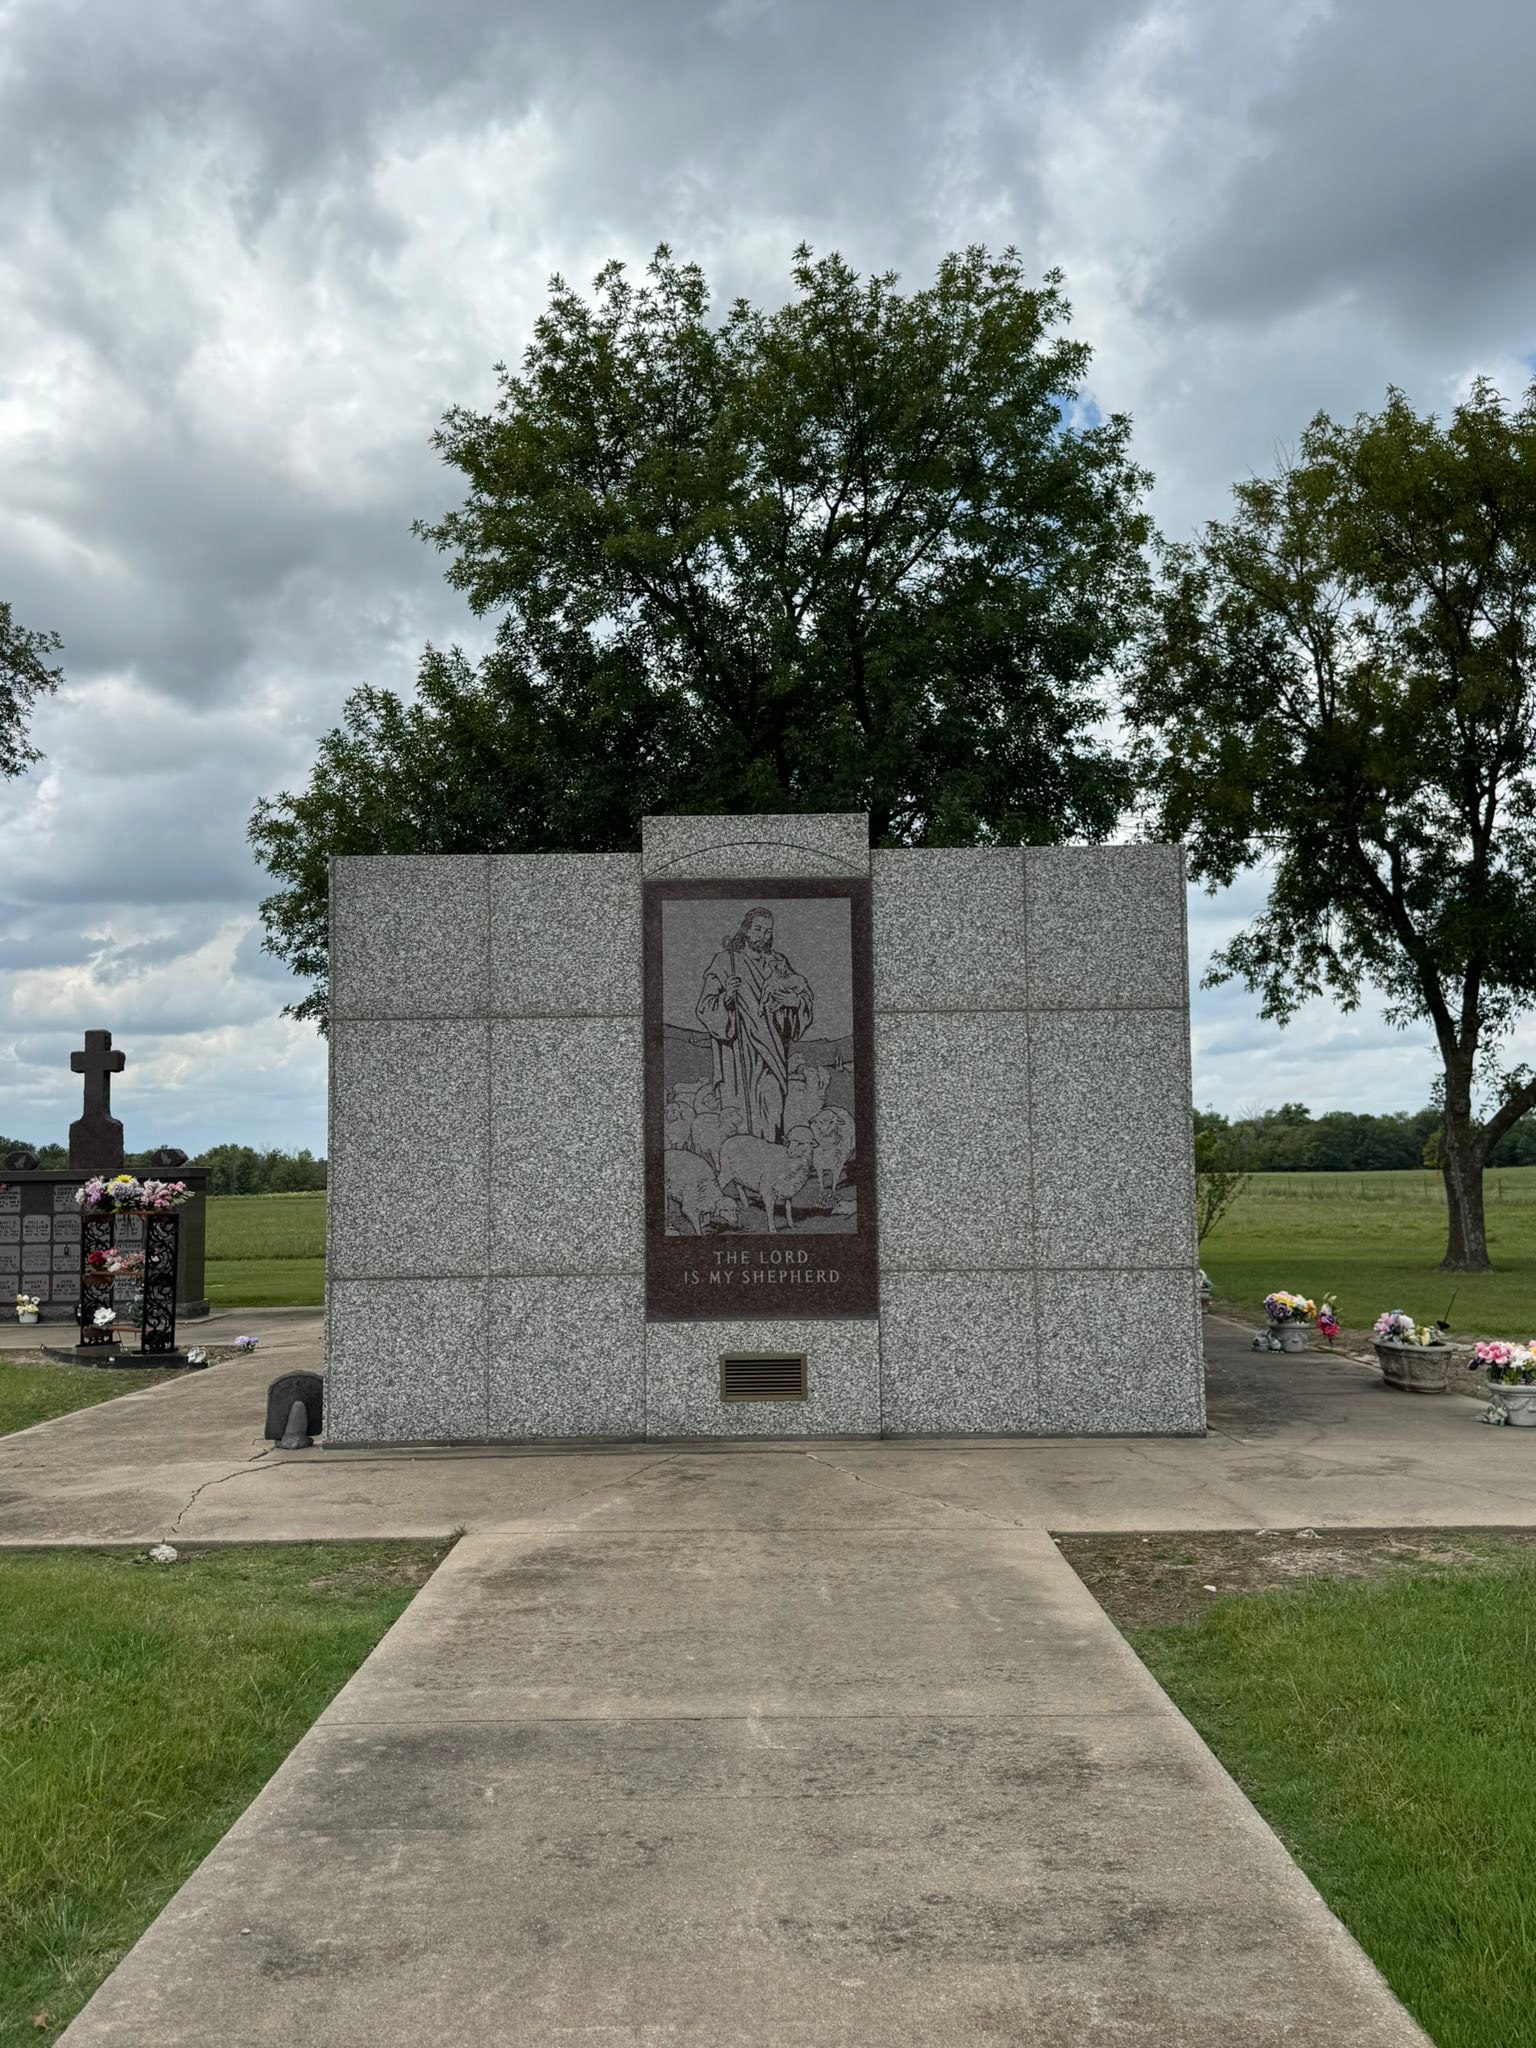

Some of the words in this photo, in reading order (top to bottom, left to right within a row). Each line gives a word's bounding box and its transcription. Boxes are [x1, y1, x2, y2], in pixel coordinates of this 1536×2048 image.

[713, 1250, 750, 1265] THE
[760, 1250, 808, 1264] LORD
[684, 1270, 700, 1285] IS
[709, 1270, 733, 1285] MY
[742, 1269, 840, 1284] SHEPHERD
